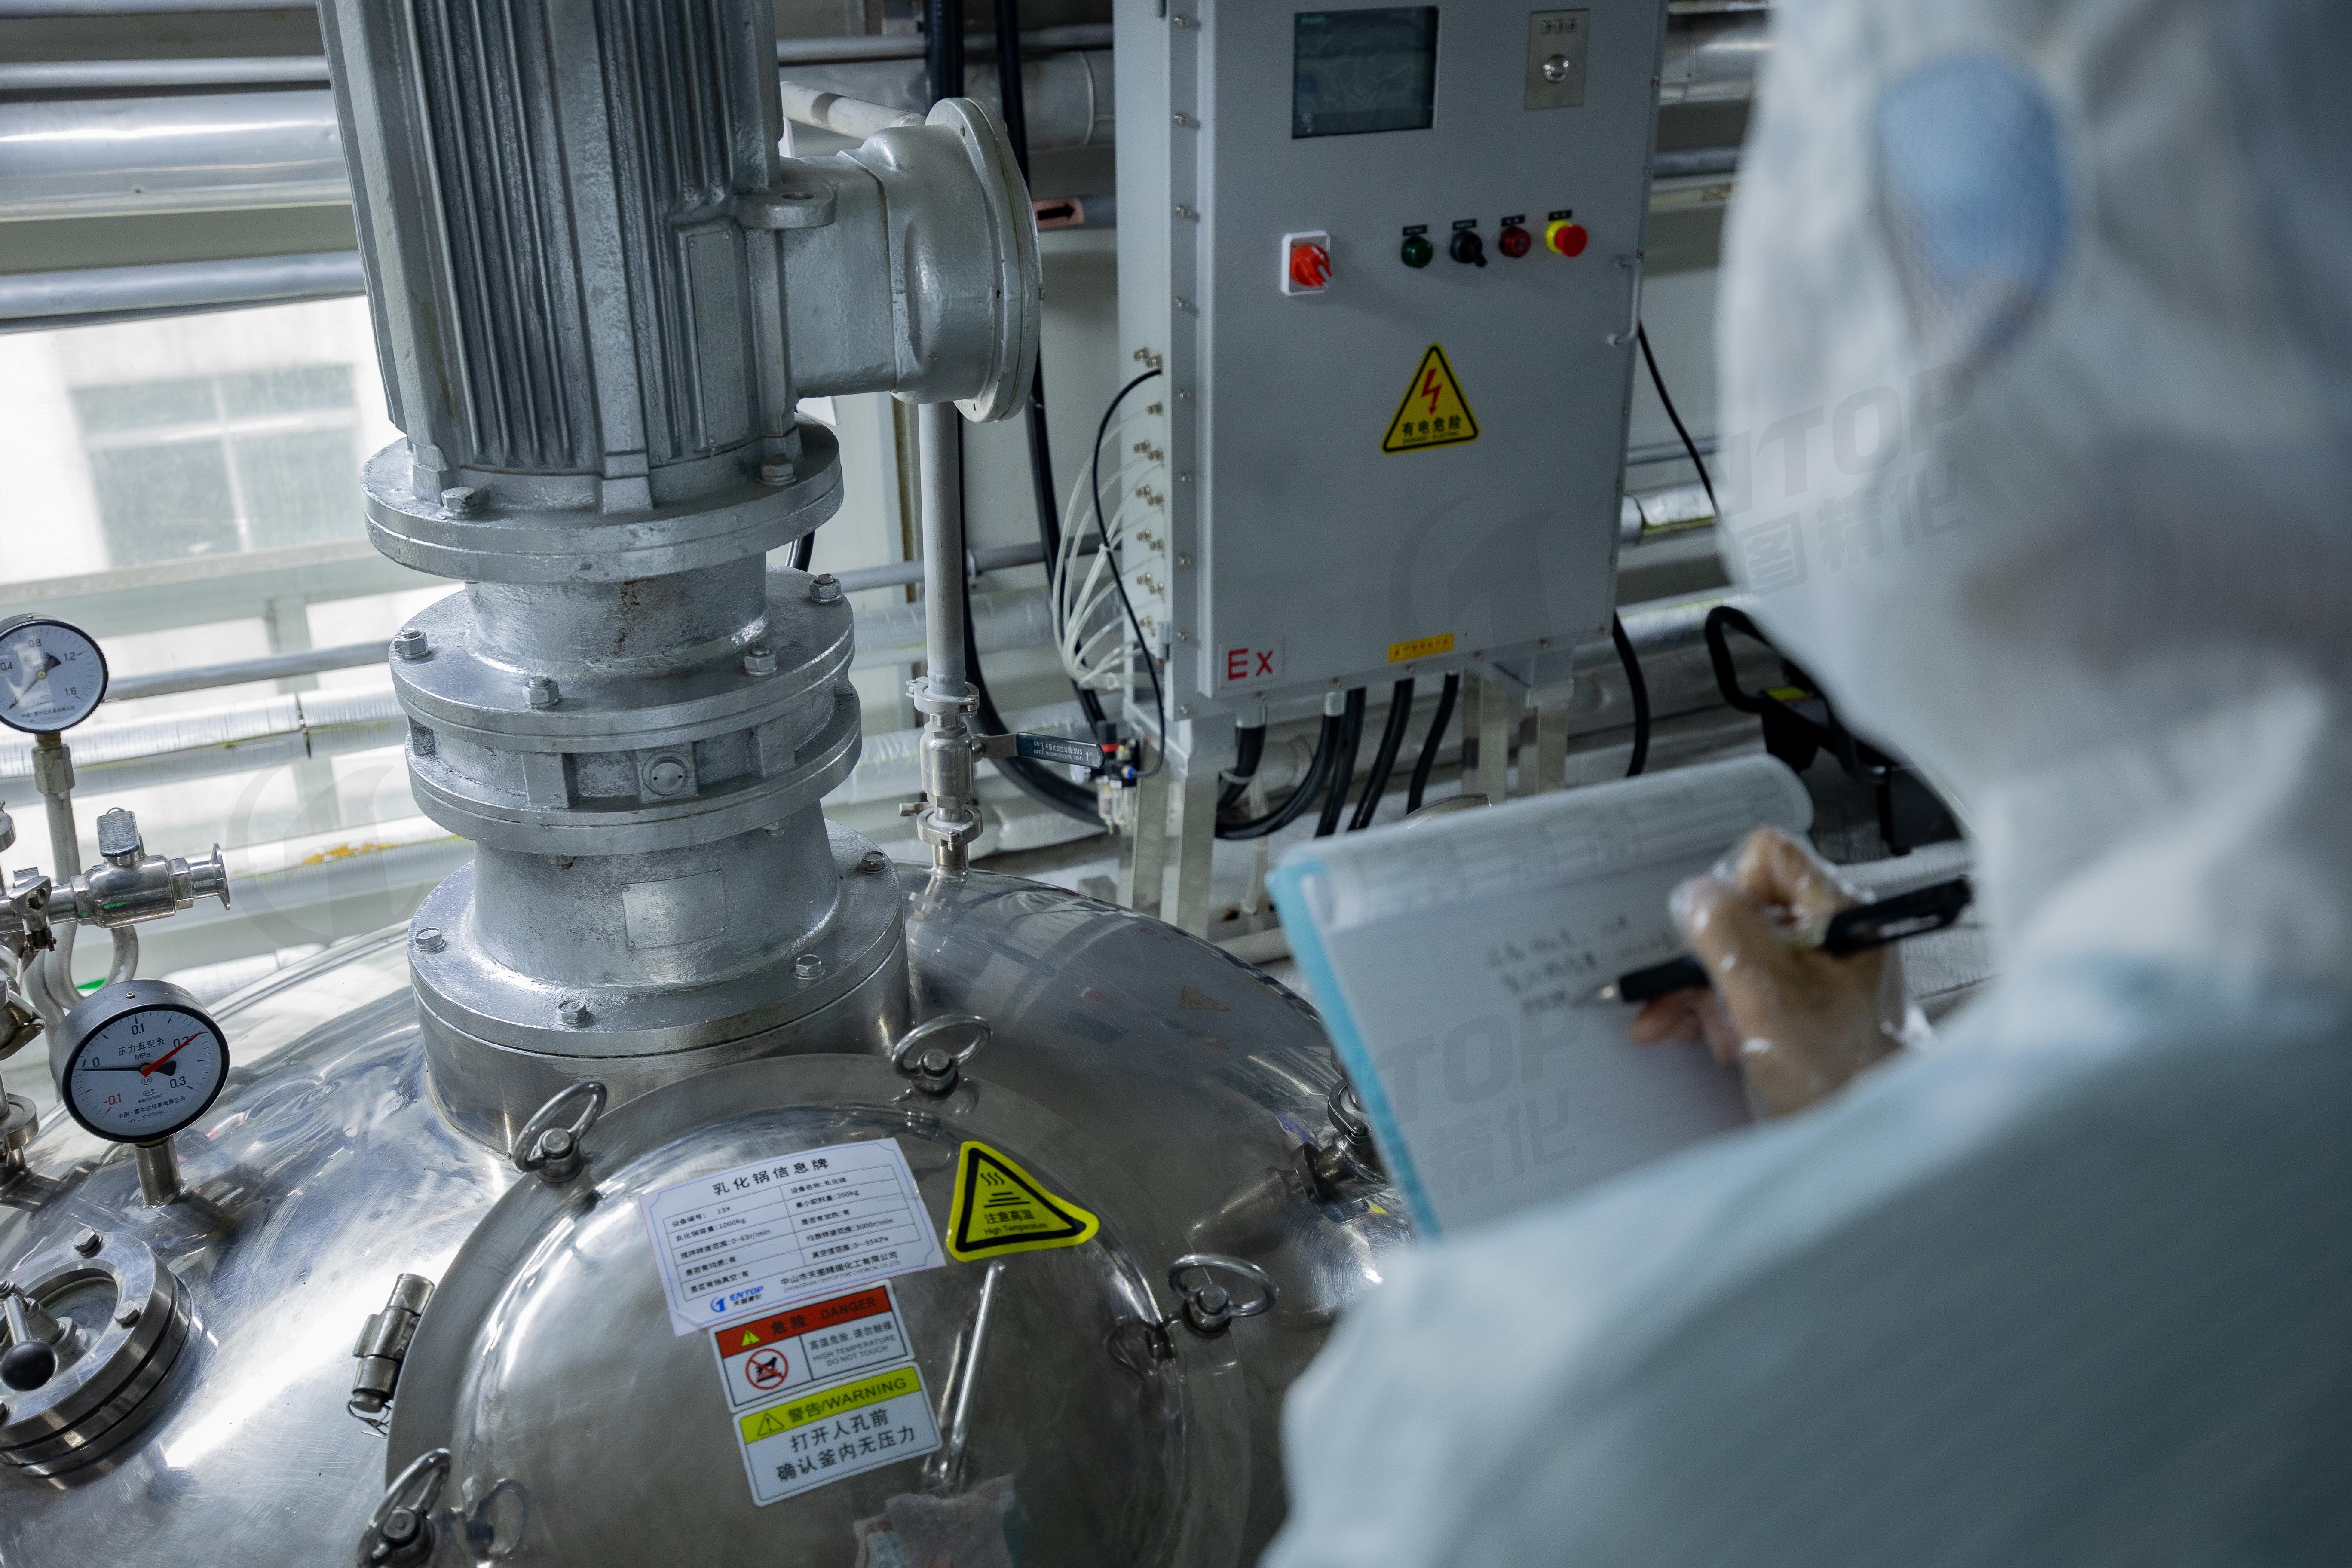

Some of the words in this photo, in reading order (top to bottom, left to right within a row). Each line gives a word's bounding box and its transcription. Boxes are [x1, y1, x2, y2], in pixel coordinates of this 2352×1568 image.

[28, 638, 41, 648] 08
[64, 652, 76, 661] 1.2
[65, 687, 77, 696] 1.6
[1073, 747, 1083, 756] SUS
[131, 1023, 145, 1035] 0.1
[118, 1036, 165, 1057] 压力真空表
[173, 1036, 190, 1049] 02
[92, 1057, 100, 1067] 0
[135, 1052, 150, 1060] MPa
[169, 1076, 186, 1089] 0.3
[102, 1093, 122, 1106] -0.1
[712, 1158, 828, 1196] 乳化锅信息牌
[985, 1210, 1035, 1224] 注意高温
[984, 1227, 1001, 1235] High
[1004, 1223, 1047, 1233] Temperature
[729, 1286, 764, 1301] ENTOP
[772, 1314, 807, 1334] 危险
[820, 1296, 877, 1320] DANGER
[812, 1351, 834, 1362] HIGH
[834, 1335, 897, 1358] TEMPERATURE
[826, 1357, 838, 1366] DO
[839, 1353, 858, 1364] NOT
[859, 1345, 888, 1360] TOUCH
[787, 1378, 907, 1424] 警告/WARNING
[789, 1409, 888, 1454] 打开人孔前
[776, 1426, 915, 1483] 确认釜内无压力
